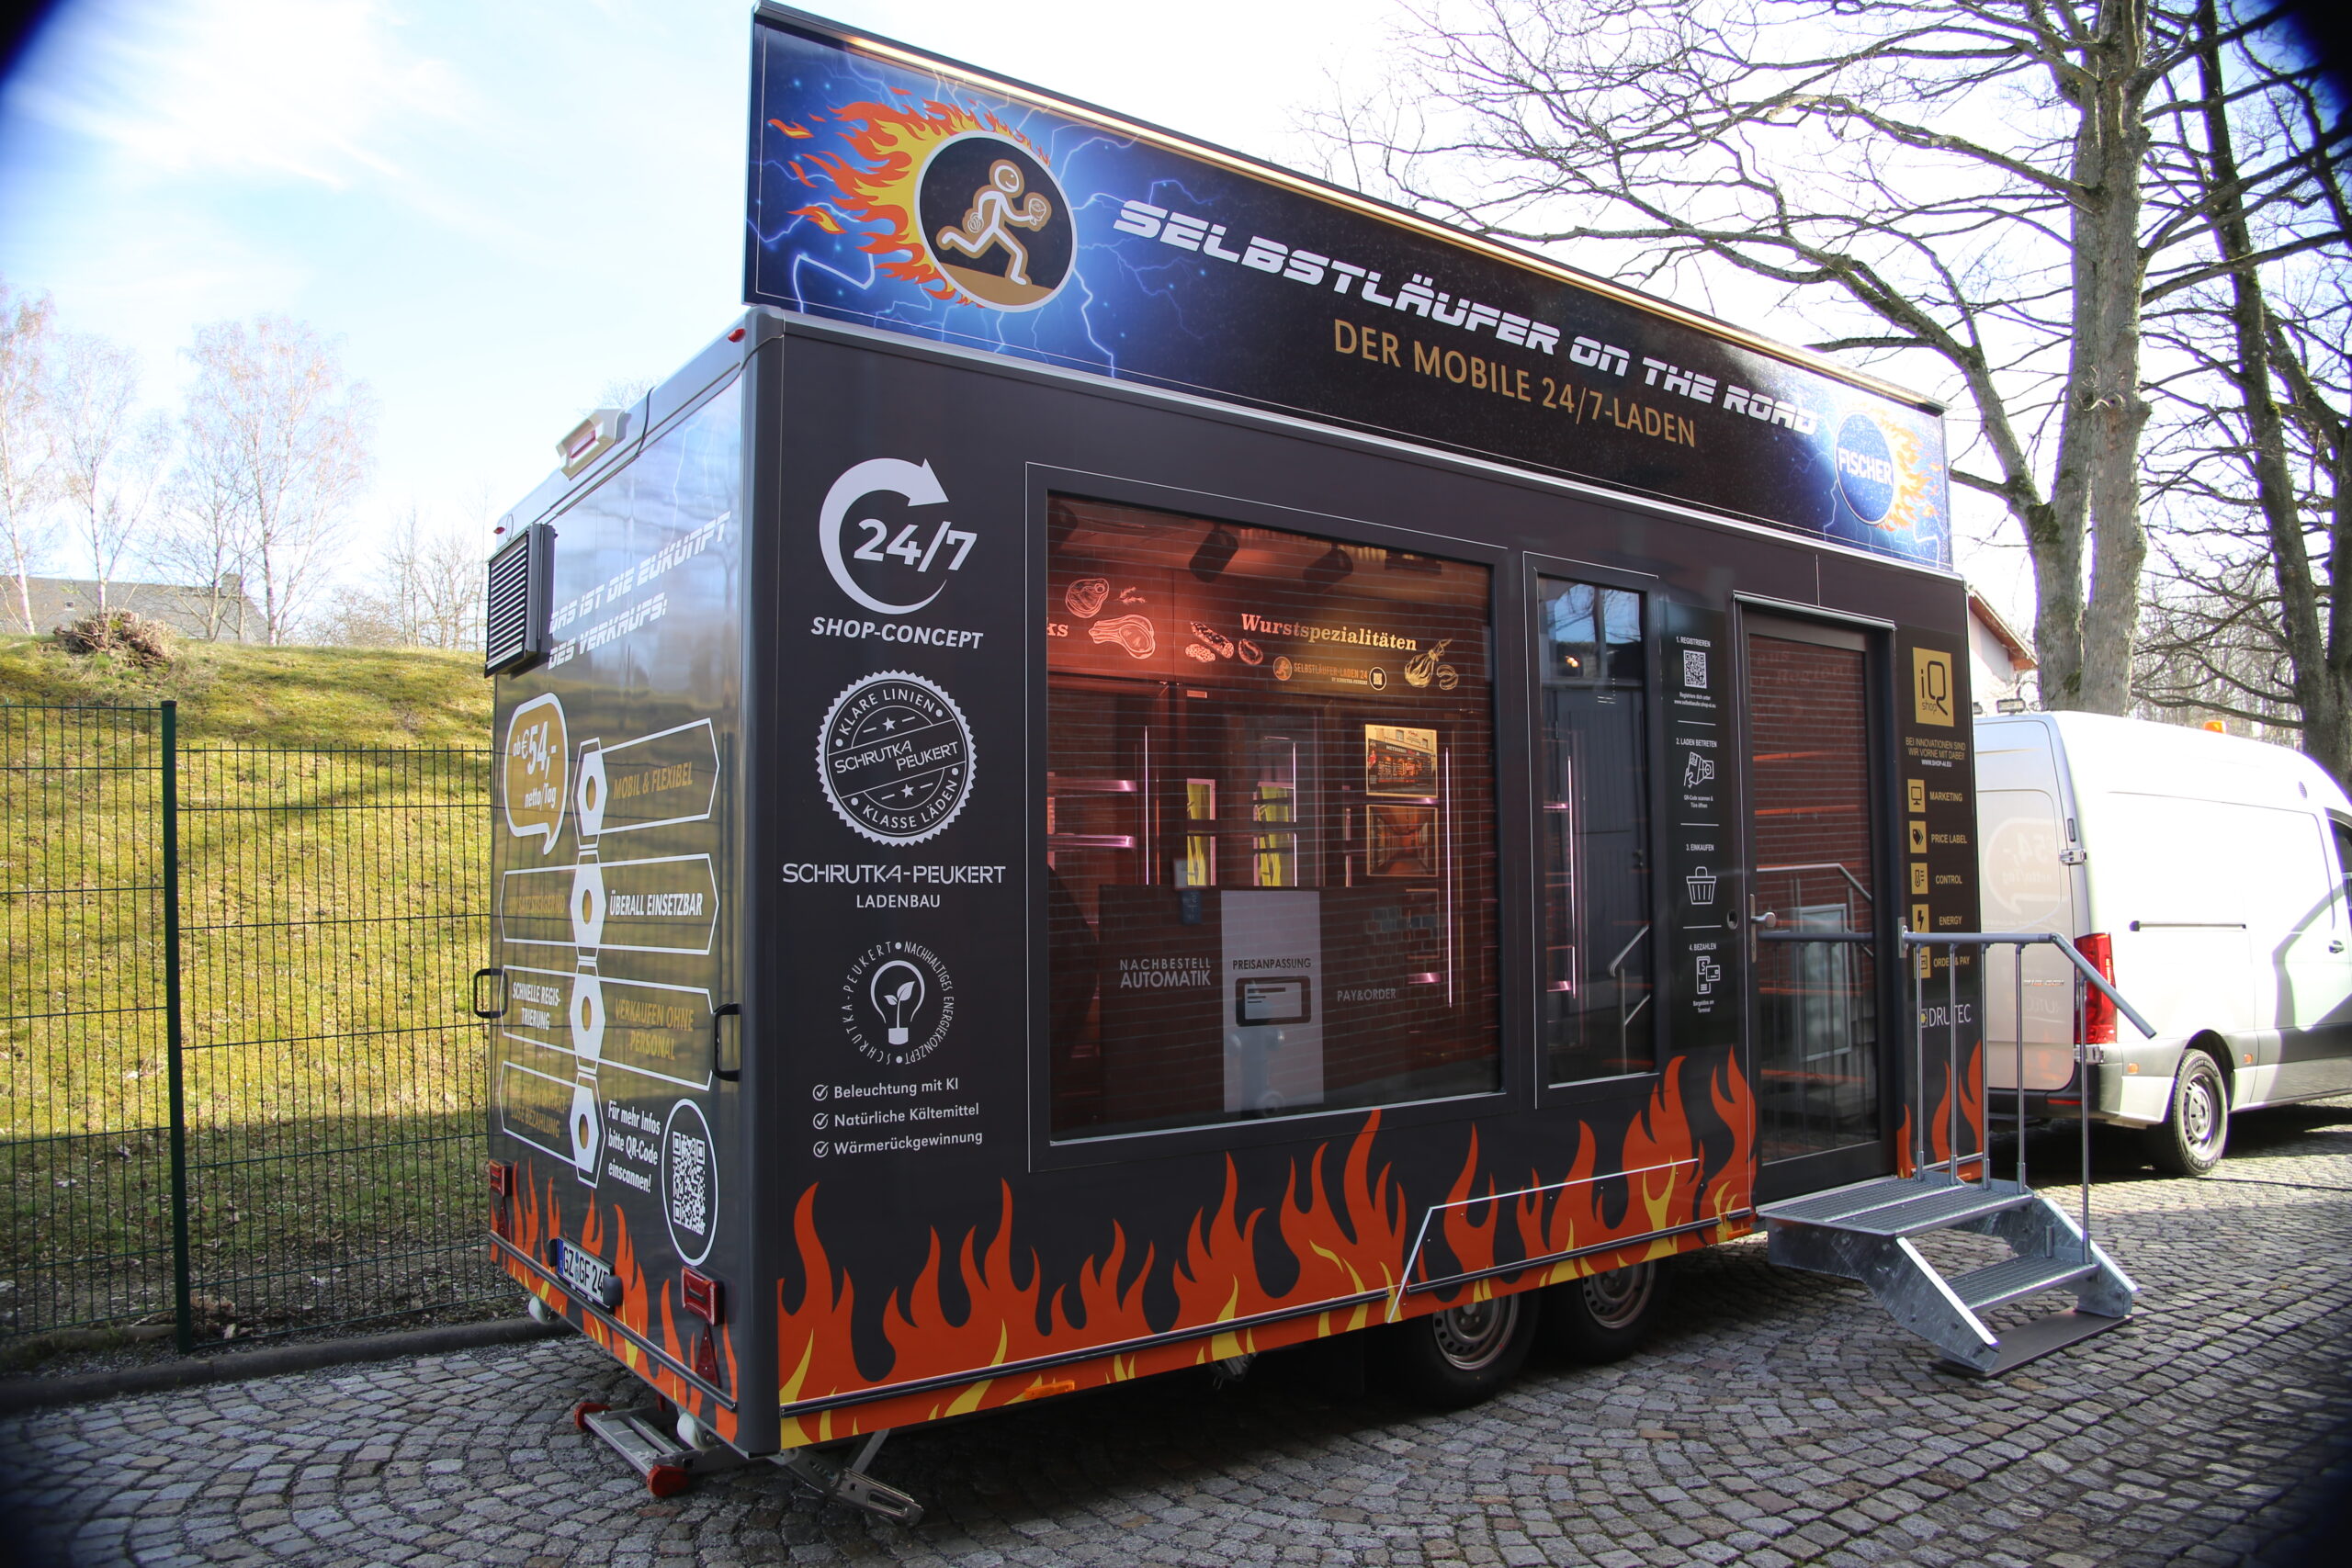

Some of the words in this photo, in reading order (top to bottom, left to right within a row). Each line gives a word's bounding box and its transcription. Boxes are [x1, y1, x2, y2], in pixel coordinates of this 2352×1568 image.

[1113, 199, 1561, 355] SELBSTLÄUFER
[1569, 335, 1630, 377] ON
[1642, 356, 1718, 404] THE
[1723, 385, 1818, 436] ROAD
[1334, 319, 1401, 367] DER
[1414, 341, 1532, 402] MOBILE
[1542, 377, 1696, 447] 24/7-LADEN
[1837, 447, 1894, 486] FISCHER
[854, 518, 978, 572] 24/7
[579, 583, 605, 617] IST
[606, 567, 635, 603] DIE
[637, 511, 731, 587] ZUKUNFT
[810, 616, 984, 649] SHOP-CONCEPT
[1240, 613, 1418, 650] Wurstspezialitäten
[1680, 637, 1711, 647] REGISTRIEREN
[548, 637, 576, 670] DES
[1361, 670, 1368, 679] 24
[838, 693, 878, 736] KLARE
[883, 688, 935, 713] LINIEN
[1922, 701, 1937, 715] shop
[513, 735, 521, 757] ab
[834, 739, 912, 773] SCHRUTKA
[896, 740, 959, 772] PEUKERT
[1680, 738, 1695, 747] LADEN
[1695, 739, 1717, 748] BETRETEN
[1905, 737, 1914, 746] BEI
[1916, 738, 1953, 750] INNOVATIONEN
[1954, 742, 1966, 750] SIND
[1908, 747, 1919, 756] WIR
[1919, 748, 1939, 758] VORNE
[1939, 750, 1948, 758] MIT
[613, 777, 640, 800] MOBIL
[642, 772, 650, 795] &
[651, 761, 693, 794] FLEXIBEL
[525, 783, 557, 811] netto/Tag
[863, 805, 917, 829] KLASSE
[921, 779, 958, 822] LÄDEN
[1929, 791, 1962, 802] MARKETING
[1931, 833, 1949, 843] PRICE
[1949, 834, 1967, 844] LABEL
[782, 863, 1006, 885] SCHRUTKA-PEUKERT
[1936, 874, 1962, 885] CONTROL
[609, 890, 644, 916] ÜBERALL
[646, 893, 703, 916] EINSETZBAR
[856, 894, 941, 908] LADENBAU
[1939, 915, 1962, 926] ENERGY
[1693, 942, 1716, 951] BEZAHLEN
[904, 941, 953, 992] NACHHALTIGES
[1119, 957, 1211, 971] NACHBESTELL
[1232, 958, 1311, 971] PREISANPASSUNG
[1933, 957, 1951, 968] ORDE
[1960, 956, 1970, 965] PAY
[1120, 970, 1211, 989] AUTOMATIK
[513, 981, 540, 1003] SCHNELLE
[540, 986, 561, 1007] REGIS-
[1337, 987, 1396, 1002] PAY&ORDER
[521, 1008, 550, 1031] TRIERUNG
[616, 998, 664, 1027] VERKAUFEN
[666, 1006, 695, 1032] OHNE
[903, 997, 955, 1065] ENERGIEKONZEPT
[629, 1031, 676, 1060] PERSONAL
[834, 1082, 917, 1099] Beleuchtung
[922, 1079, 943, 1092] mit
[946, 1077, 959, 1090] KI
[525, 1108, 560, 1138] BEZAHLUNG
[608, 1100, 620, 1120] Für
[620, 1107, 639, 1127] mehr
[641, 1110, 661, 1135] Infos
[834, 1110, 905, 1127] Natürliche
[910, 1102, 979, 1121] Kältemittel
[608, 1128, 624, 1152] bitte
[626, 1135, 659, 1166] QR-Code
[834, 1132, 983, 1155] Wärmerückgewinnung
[608, 1158, 651, 1193] einscannen!
[563, 1247, 574, 1278] GZ
[579, 1257, 591, 1287] GF
[592, 1265, 608, 1297] 24
